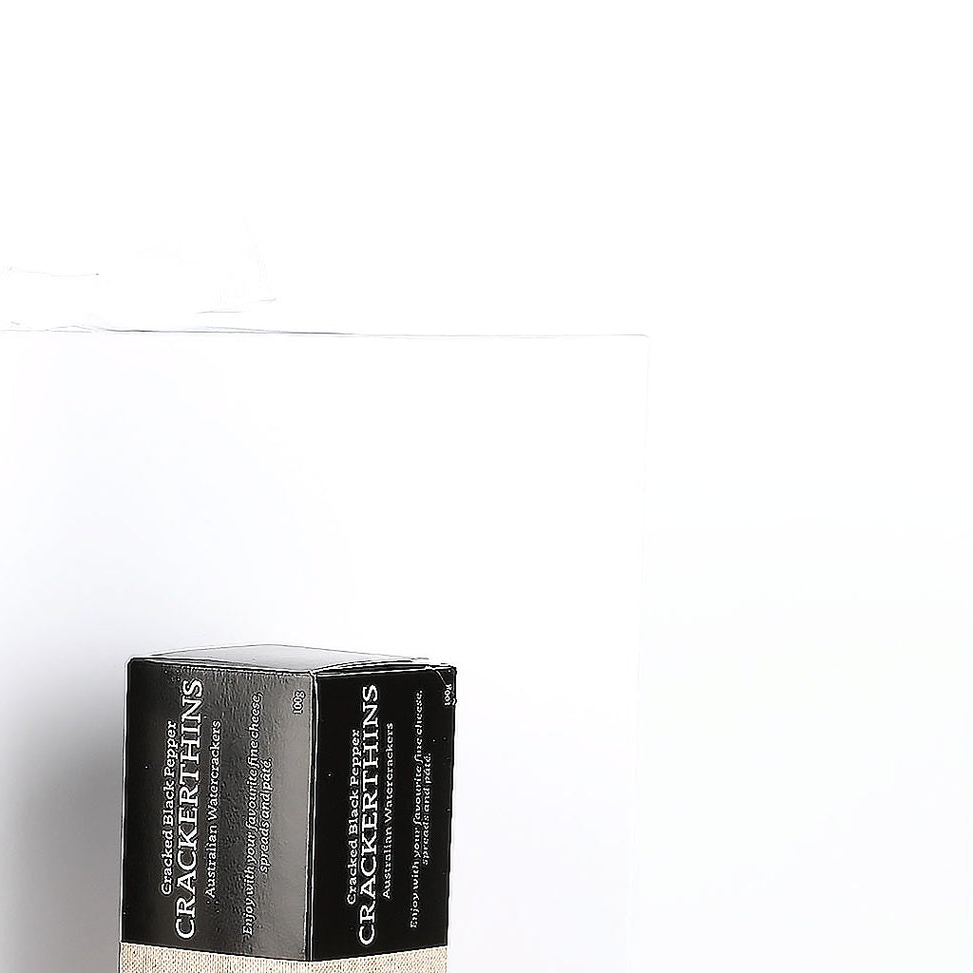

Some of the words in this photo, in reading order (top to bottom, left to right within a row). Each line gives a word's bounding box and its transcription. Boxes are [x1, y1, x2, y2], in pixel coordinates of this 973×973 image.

[164, 720, 179, 778] Pepper
[207, 720, 221, 821] Watercrackers
[247, 741, 260, 768] fine
[350, 729, 362, 786] Pepper
[163, 779, 175, 827] Black
[175, 679, 203, 939] CRACKERTHINS
[246, 768, 259, 831] favourite
[260, 791, 271, 819] and
[348, 789, 359, 835] Black
[359, 685, 379, 945] CRACKERTHINS
[161, 829, 173, 895] Cracked
[205, 824, 217, 899] Australian
[246, 831, 257, 866] your
[259, 821, 271, 873] spreads
[347, 839, 358, 905] Cracked
[382, 826, 393, 899] Australian
[244, 868, 255, 895] with
[243, 898, 256, 936] Enjoy
